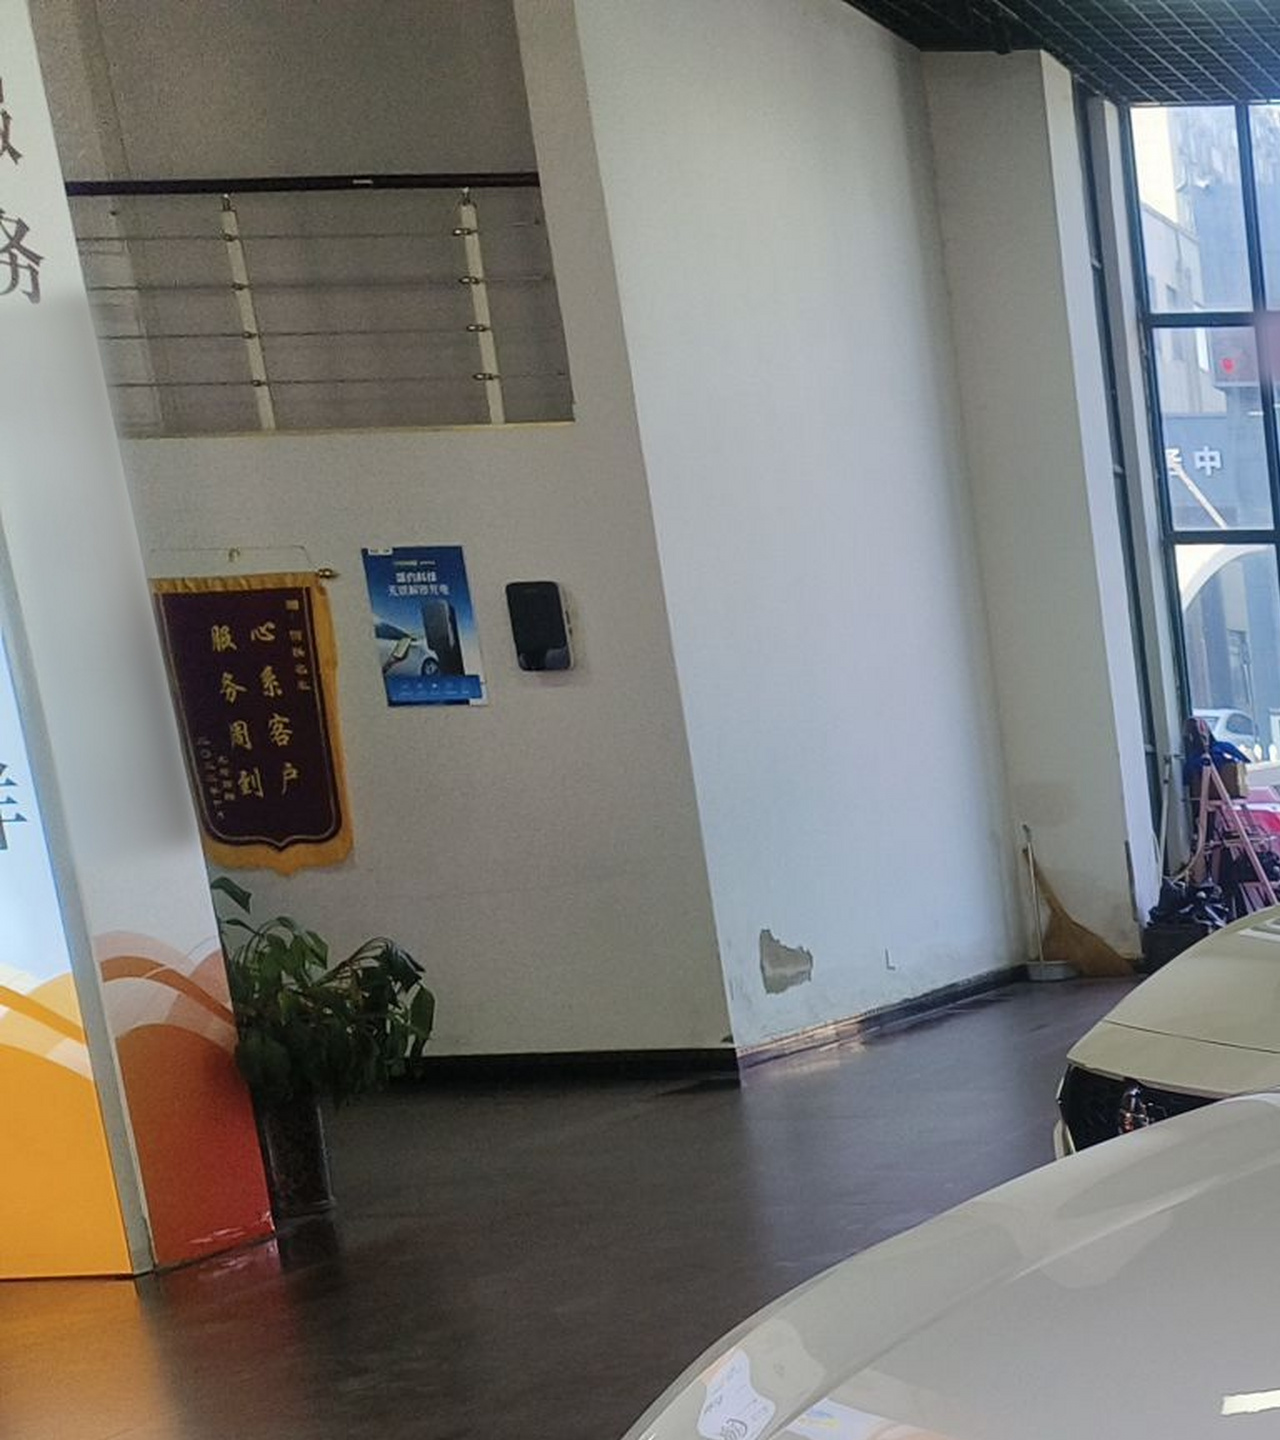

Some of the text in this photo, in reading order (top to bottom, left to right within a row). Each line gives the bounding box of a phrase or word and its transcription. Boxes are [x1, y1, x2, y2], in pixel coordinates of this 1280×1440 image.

[210, 624, 265, 798] 服务周到
[250, 621, 300, 795] 心系客户
